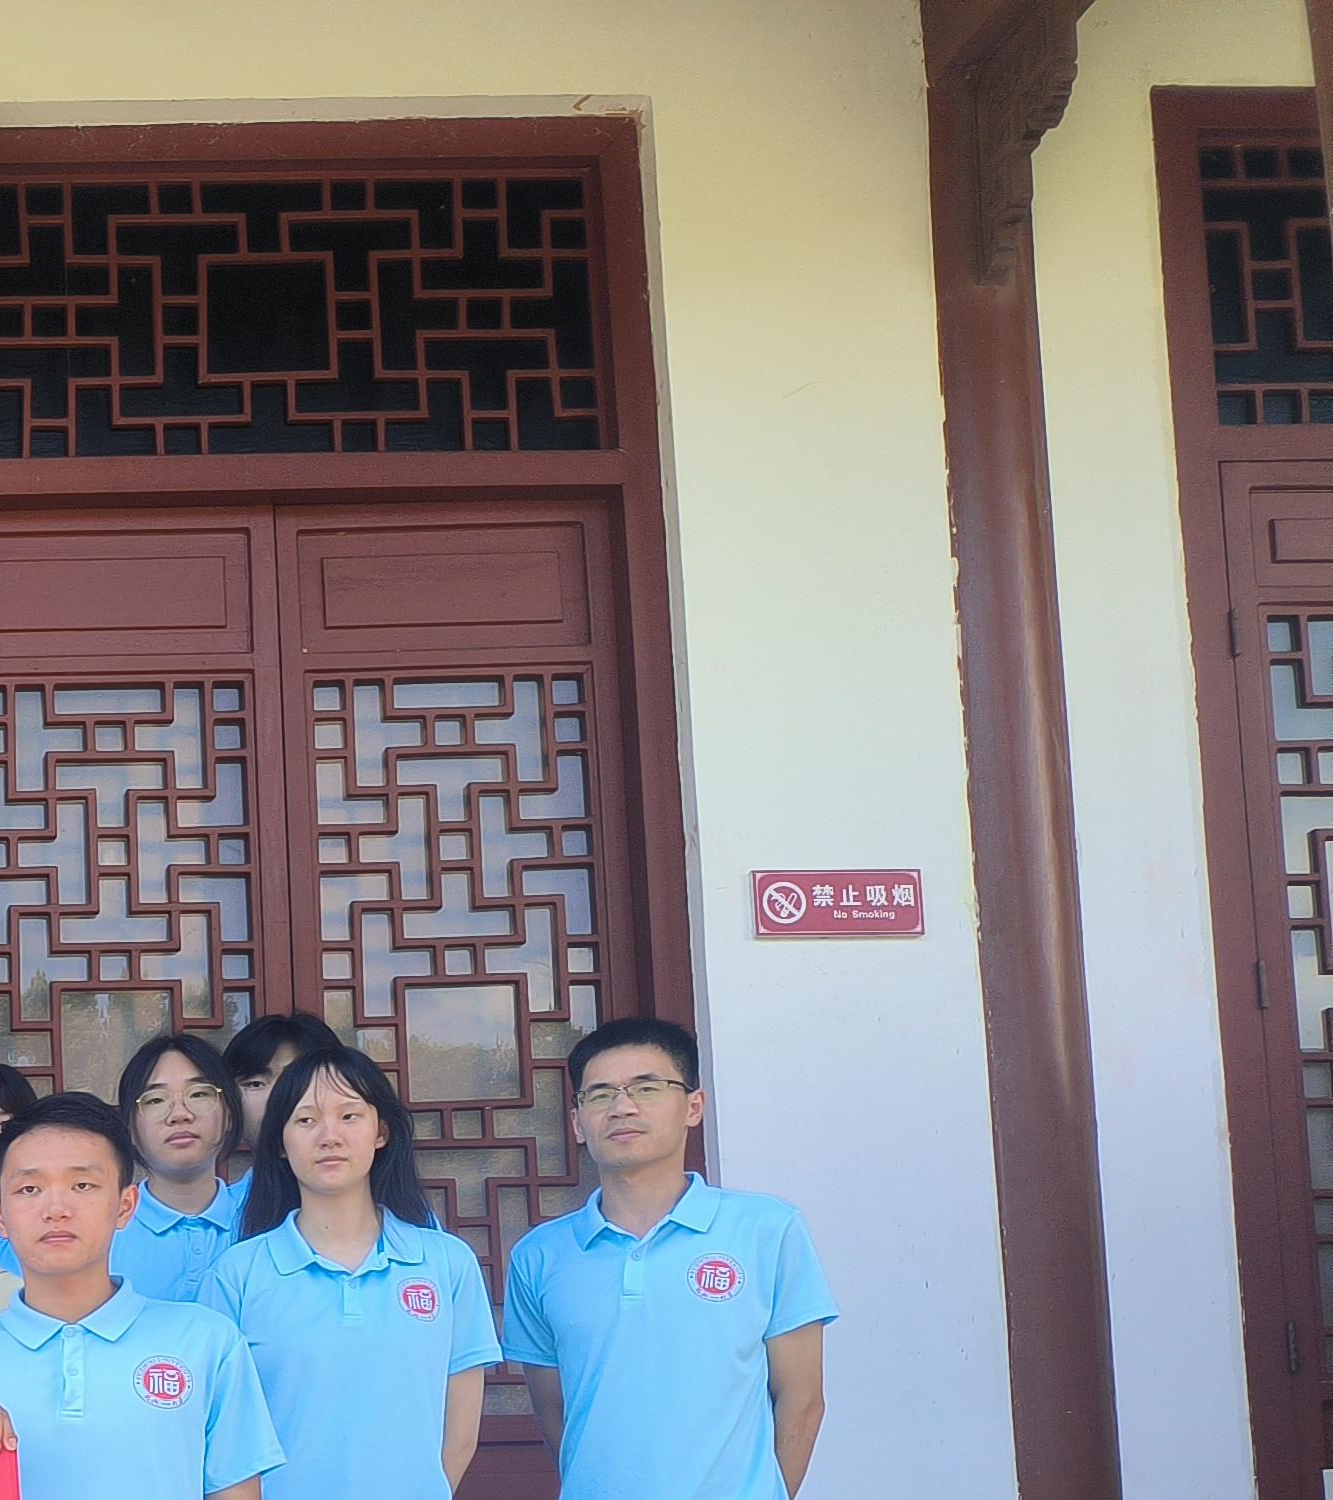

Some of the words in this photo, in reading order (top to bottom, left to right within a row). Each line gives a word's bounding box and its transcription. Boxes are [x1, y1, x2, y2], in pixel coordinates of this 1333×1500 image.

[811, 884, 916, 907] 禁止吸烟
[833, 909, 848, 919] No
[851, 909, 896, 920] Smoking
[702, 1265, 731, 1290] 福
[405, 1289, 433, 1310] 福
[149, 1369, 180, 1396] 福
